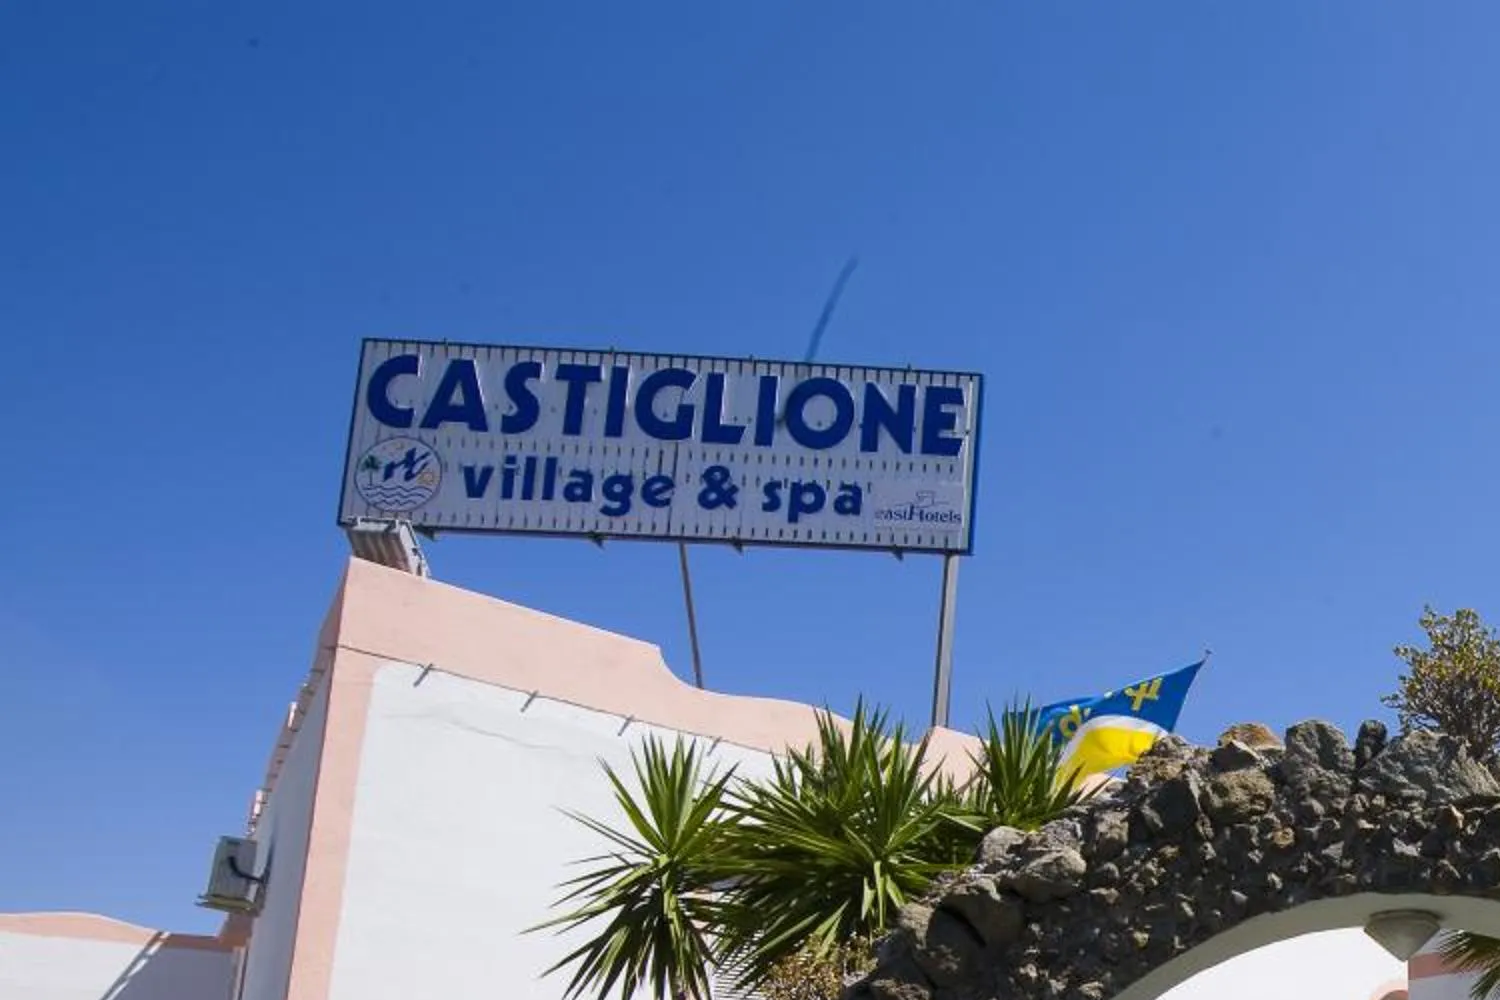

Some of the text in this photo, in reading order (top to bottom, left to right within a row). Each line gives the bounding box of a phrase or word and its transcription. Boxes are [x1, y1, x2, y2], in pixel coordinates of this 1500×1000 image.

[367, 354, 964, 456] CASTIGLIONE
[462, 455, 863, 523] village & spa
